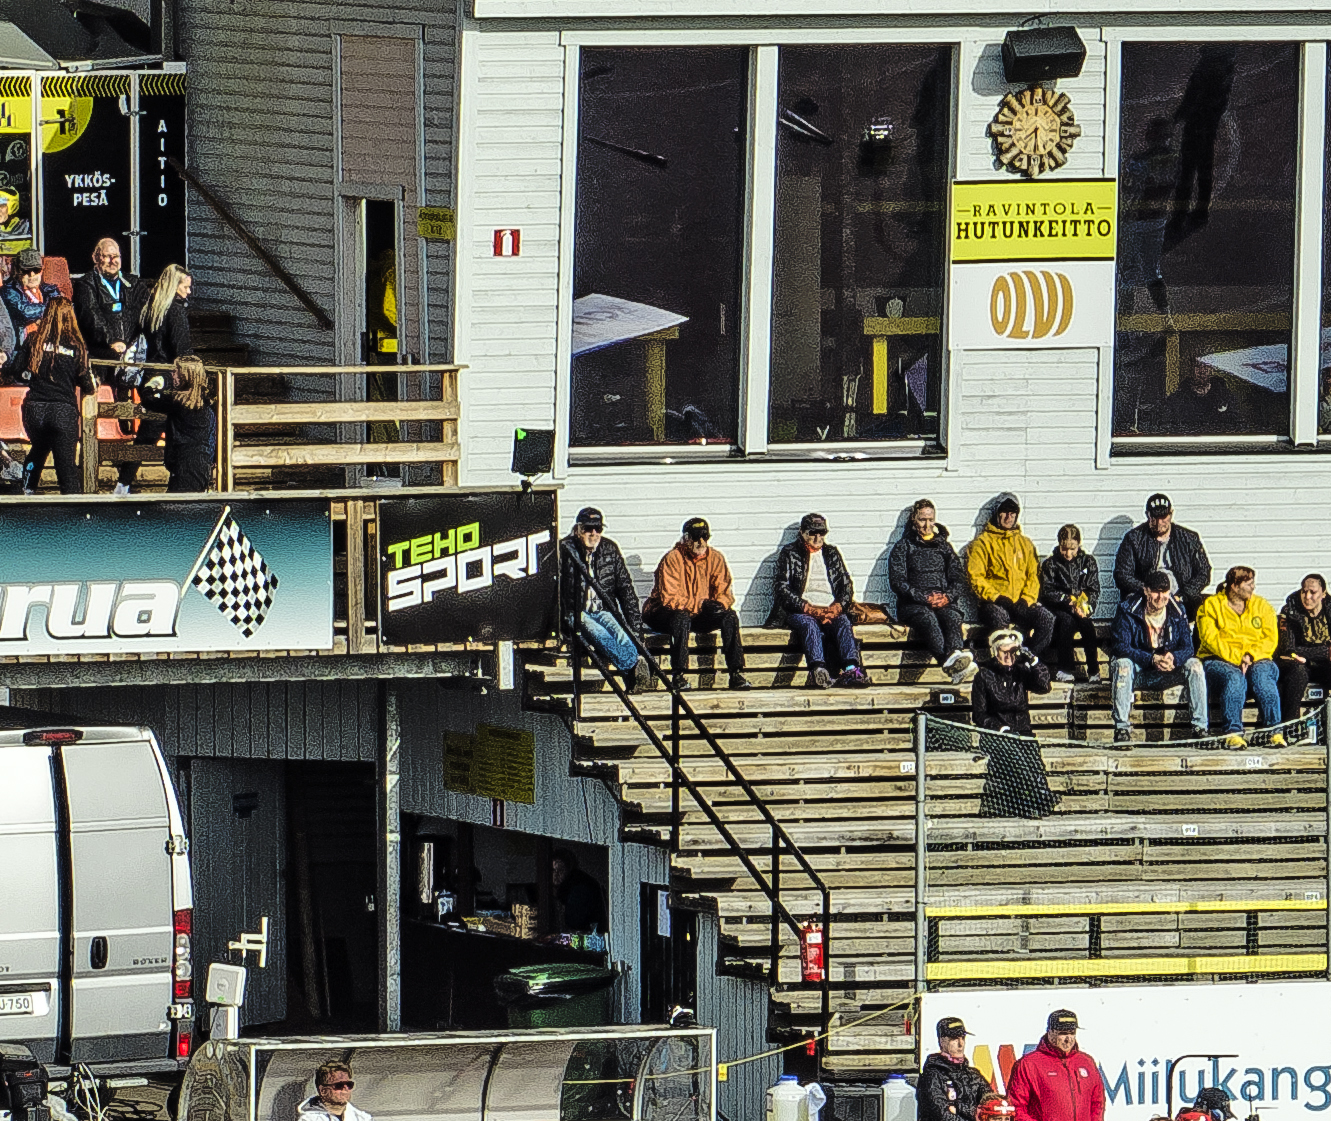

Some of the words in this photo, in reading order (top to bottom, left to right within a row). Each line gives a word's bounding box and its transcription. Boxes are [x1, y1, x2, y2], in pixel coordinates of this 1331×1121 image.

[64, 170, 116, 188] YKKÖS-
[157, 119, 168, 206] AITIO
[73, 189, 108, 206] PESÄ
[972, 202, 1095, 217] RAVINTOLA
[956, 219, 1111, 240] HUTUNKEITTO
[990, 269, 1074, 340] OLVI
[388, 521, 480, 569] TEHO
[388, 529, 551, 613] SPORT
